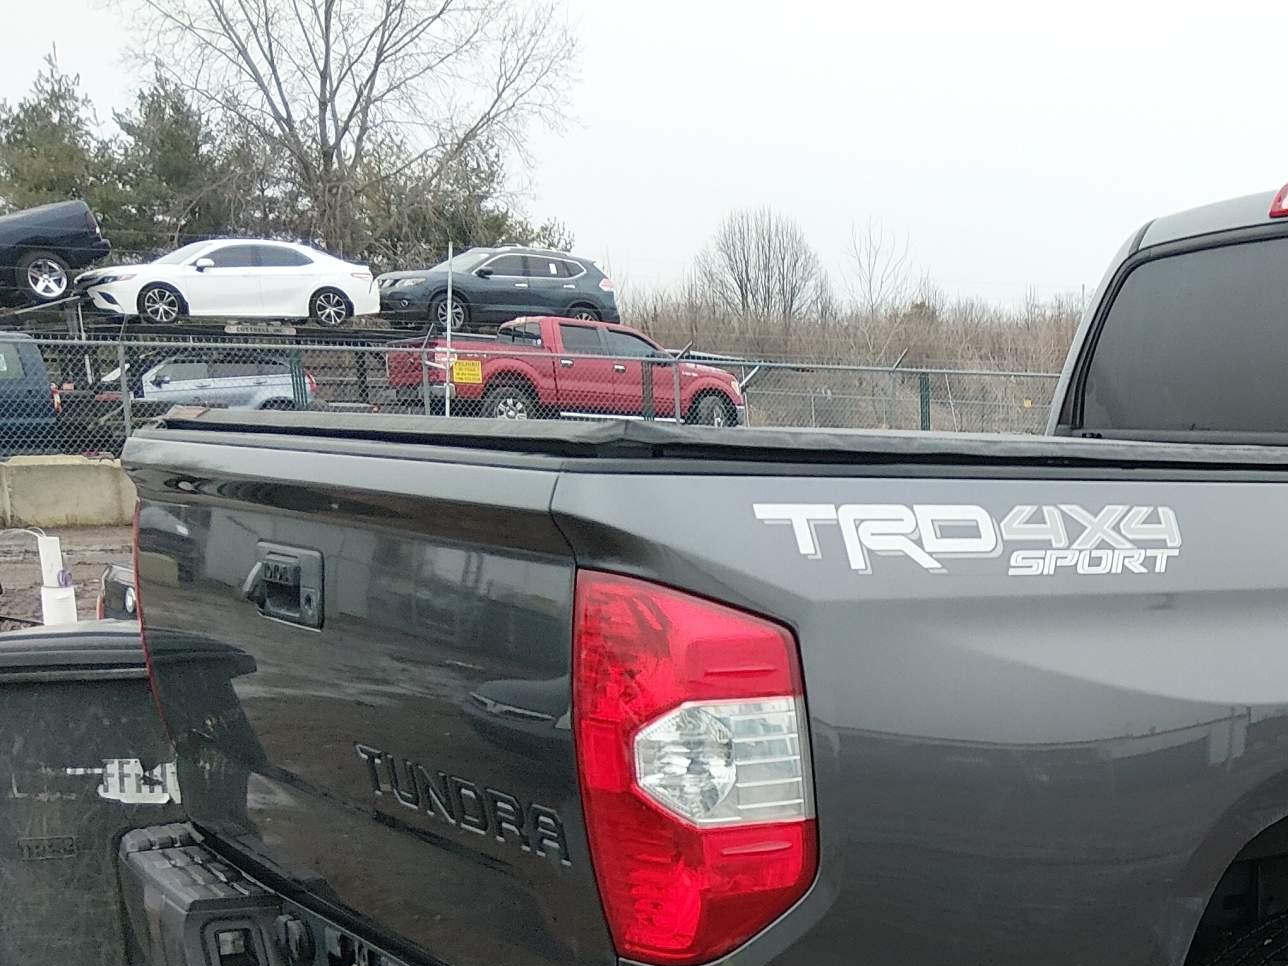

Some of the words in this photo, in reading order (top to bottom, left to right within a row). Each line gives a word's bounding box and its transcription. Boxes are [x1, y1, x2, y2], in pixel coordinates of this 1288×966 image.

[753, 503, 1001, 575] TRD
[1000, 504, 1182, 549] 4X4
[1008, 549, 1179, 576] SPORT
[354, 743, 572, 866] TUNDRA
